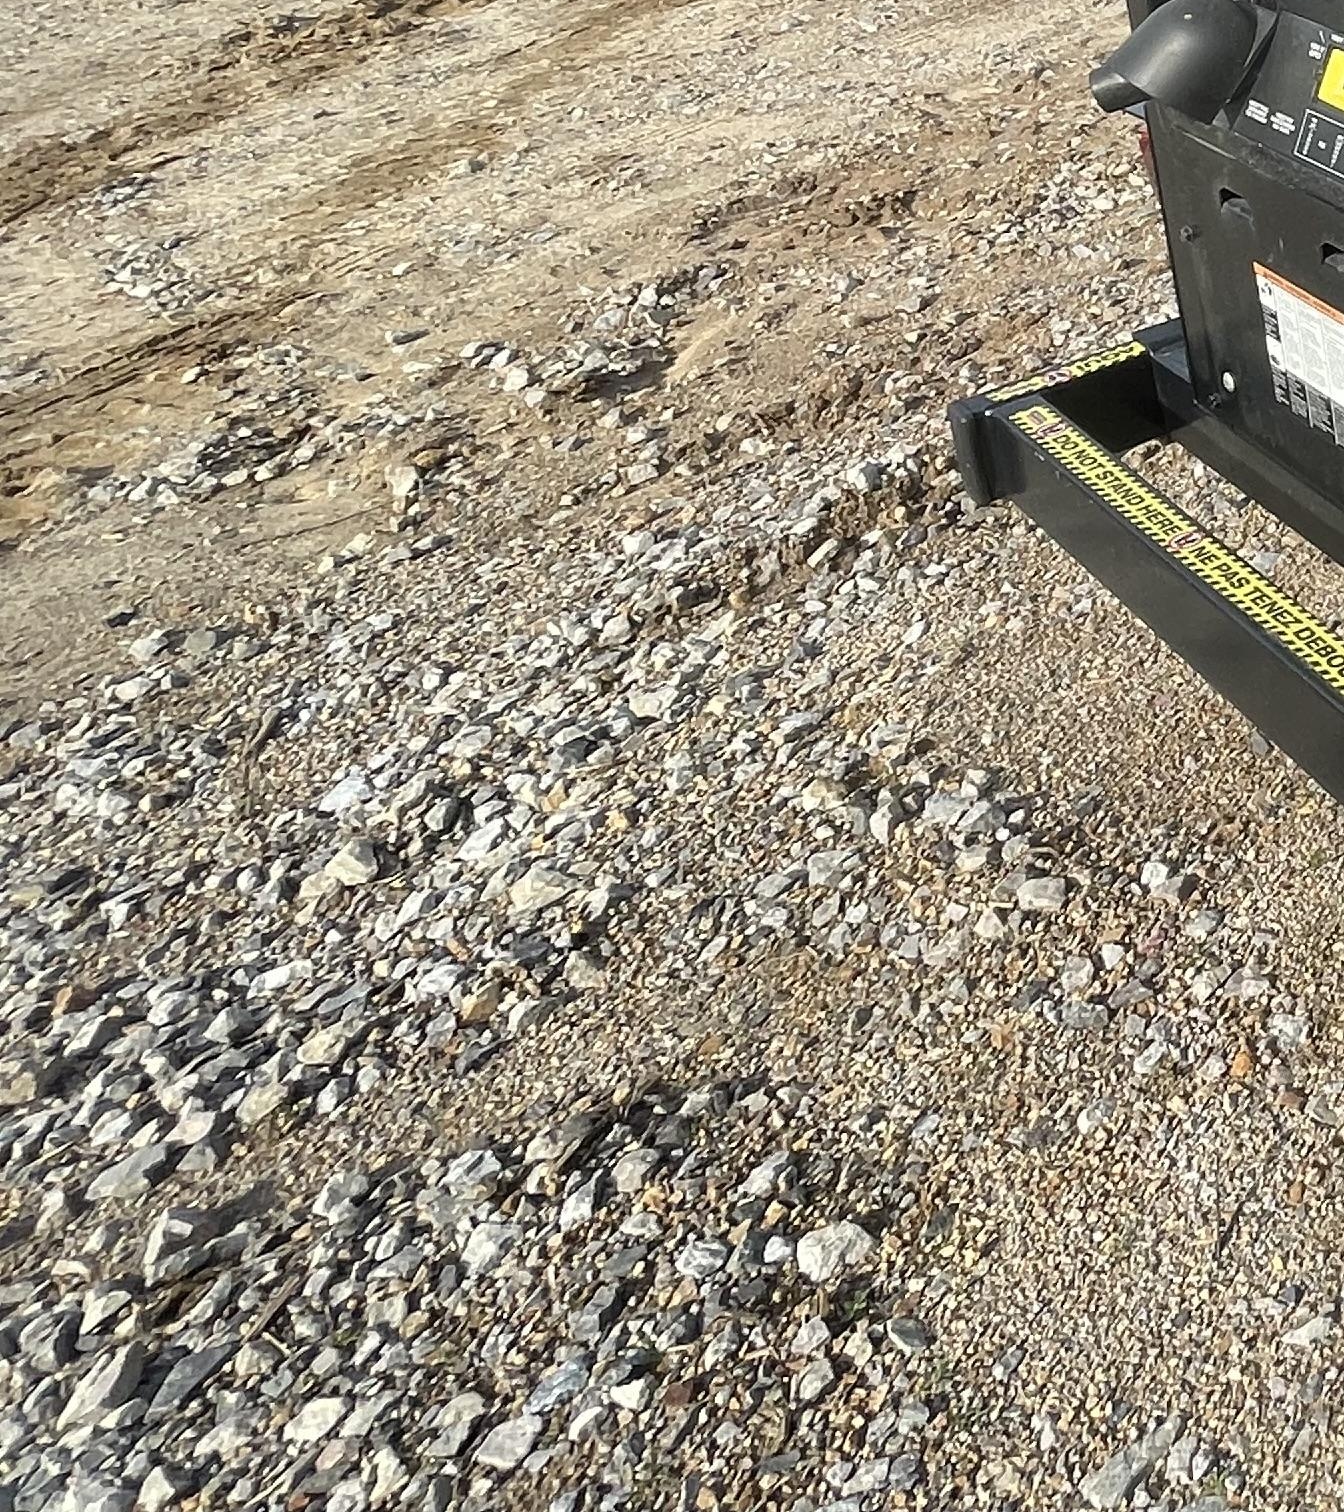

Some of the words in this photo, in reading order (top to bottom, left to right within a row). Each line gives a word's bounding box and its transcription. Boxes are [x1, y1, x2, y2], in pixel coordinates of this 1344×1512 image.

[1052, 433, 1079, 451] DO
[1073, 449, 1102, 473] NOT
[1094, 467, 1145, 508] STAND
[1137, 501, 1182, 537] HERE
[1189, 544, 1214, 567] NE
[1212, 561, 1250, 590] PAS
[1248, 585, 1305, 630] TENEZ
